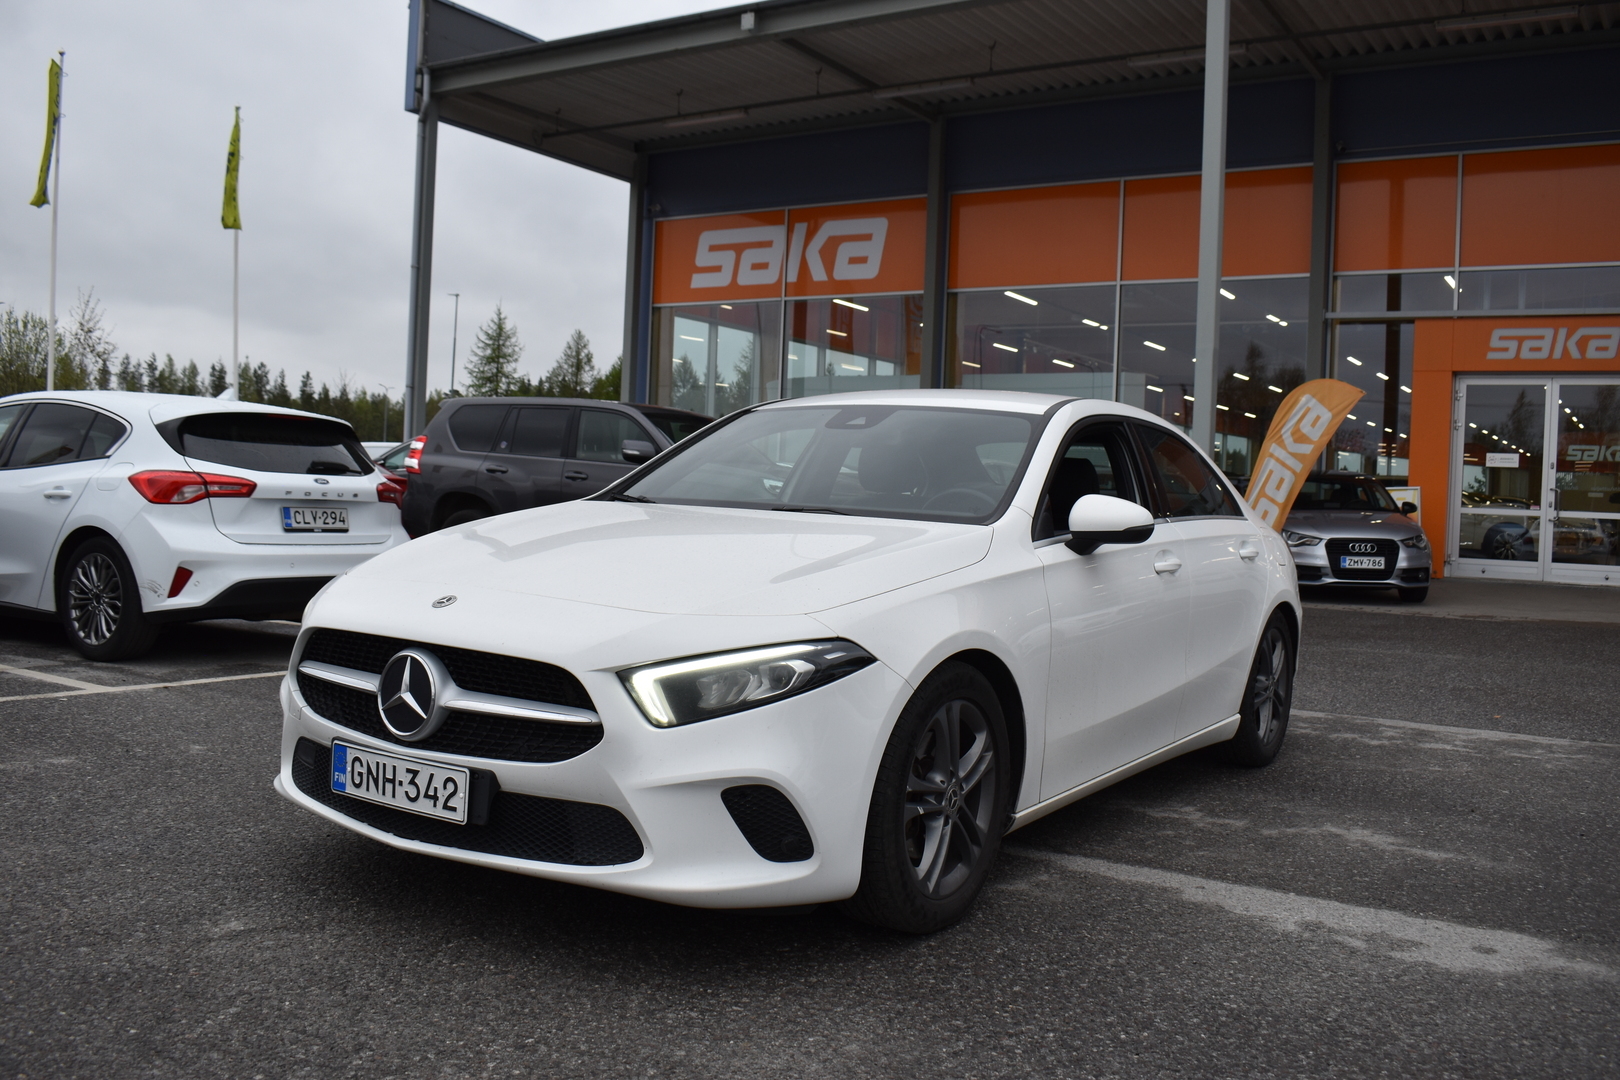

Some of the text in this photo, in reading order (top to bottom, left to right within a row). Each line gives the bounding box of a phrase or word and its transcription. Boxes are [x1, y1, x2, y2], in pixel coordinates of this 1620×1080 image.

[293, 510, 346, 525] CLV-294
[1347, 558, 1383, 567] ZMV-786
[334, 756, 458, 812] FIN GNH-342
